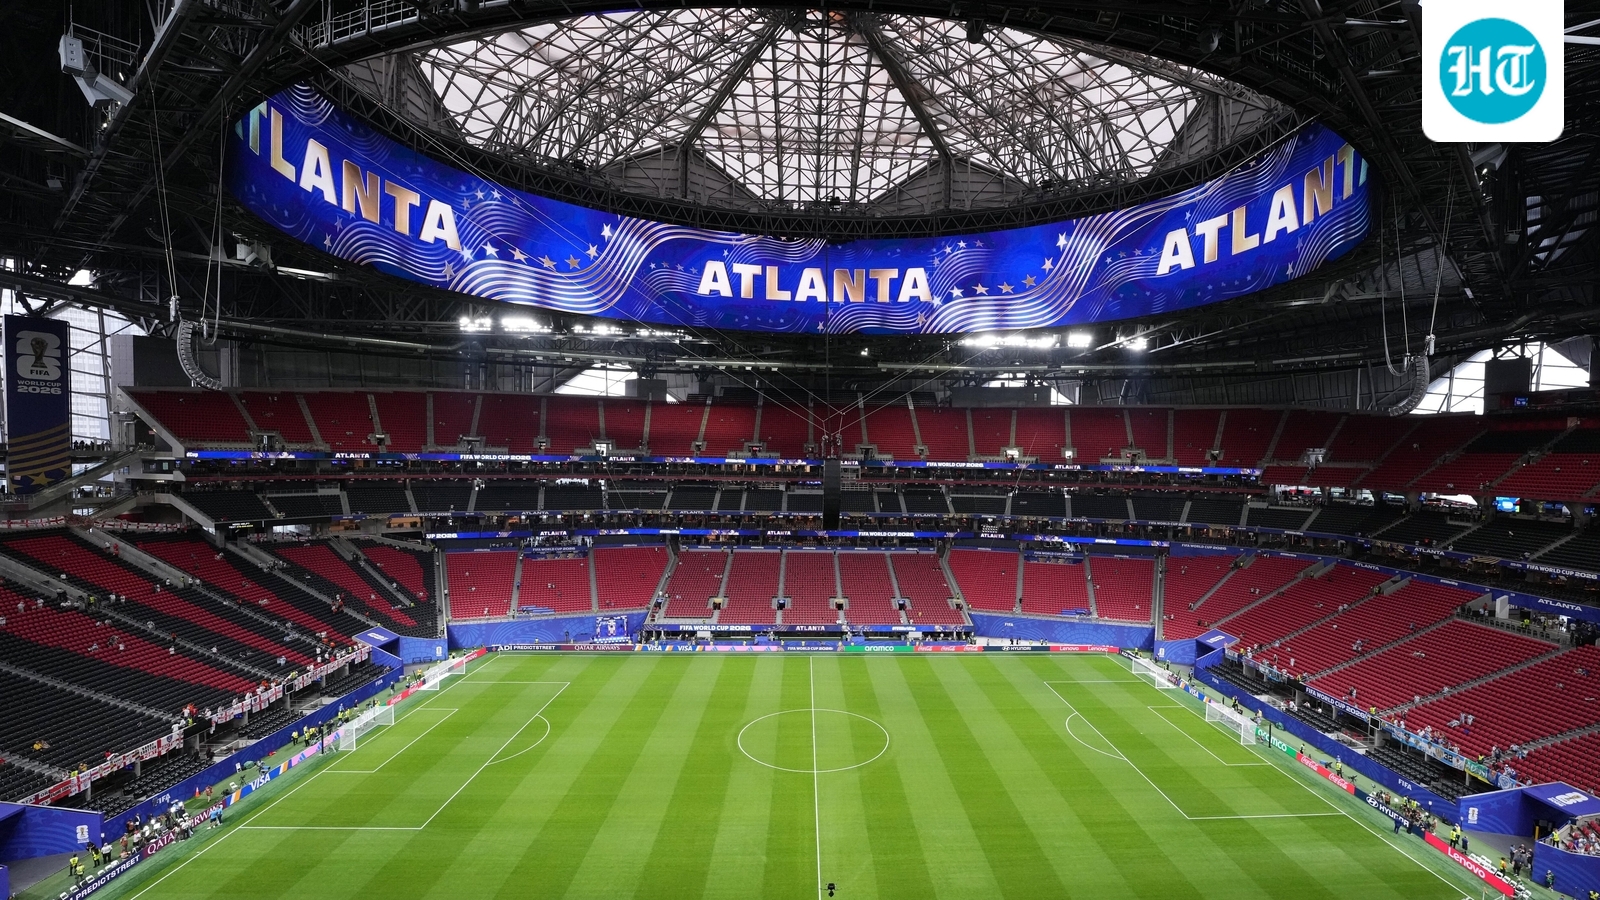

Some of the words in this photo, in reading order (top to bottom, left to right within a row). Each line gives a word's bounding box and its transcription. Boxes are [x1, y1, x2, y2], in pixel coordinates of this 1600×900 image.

[235, 101, 461, 251] TLANTA
[697, 260, 933, 303] ATLANTA
[17, 385, 62, 394] 2026
[1414, 547, 1445, 556] ATLANTA
[1354, 562, 1380, 570] ATLANTA
[1540, 566, 1561, 574] WORLD
[1575, 572, 1598, 580] 2026
[1538, 598, 1582, 611] ATLANTA
[1306, 687, 1316, 696] FIFA
[1317, 692, 1334, 704] WORLD
[1335, 701, 1345, 709] CUP
[1346, 706, 1367, 719] 2026
[250, 773, 271, 791] VISA
[1398, 779, 1412, 791] FIFA
[147, 832, 175, 854] QATA
[1448, 847, 1486, 879] Lenovo
[75, 854, 140, 900] PREDICTSTREET
